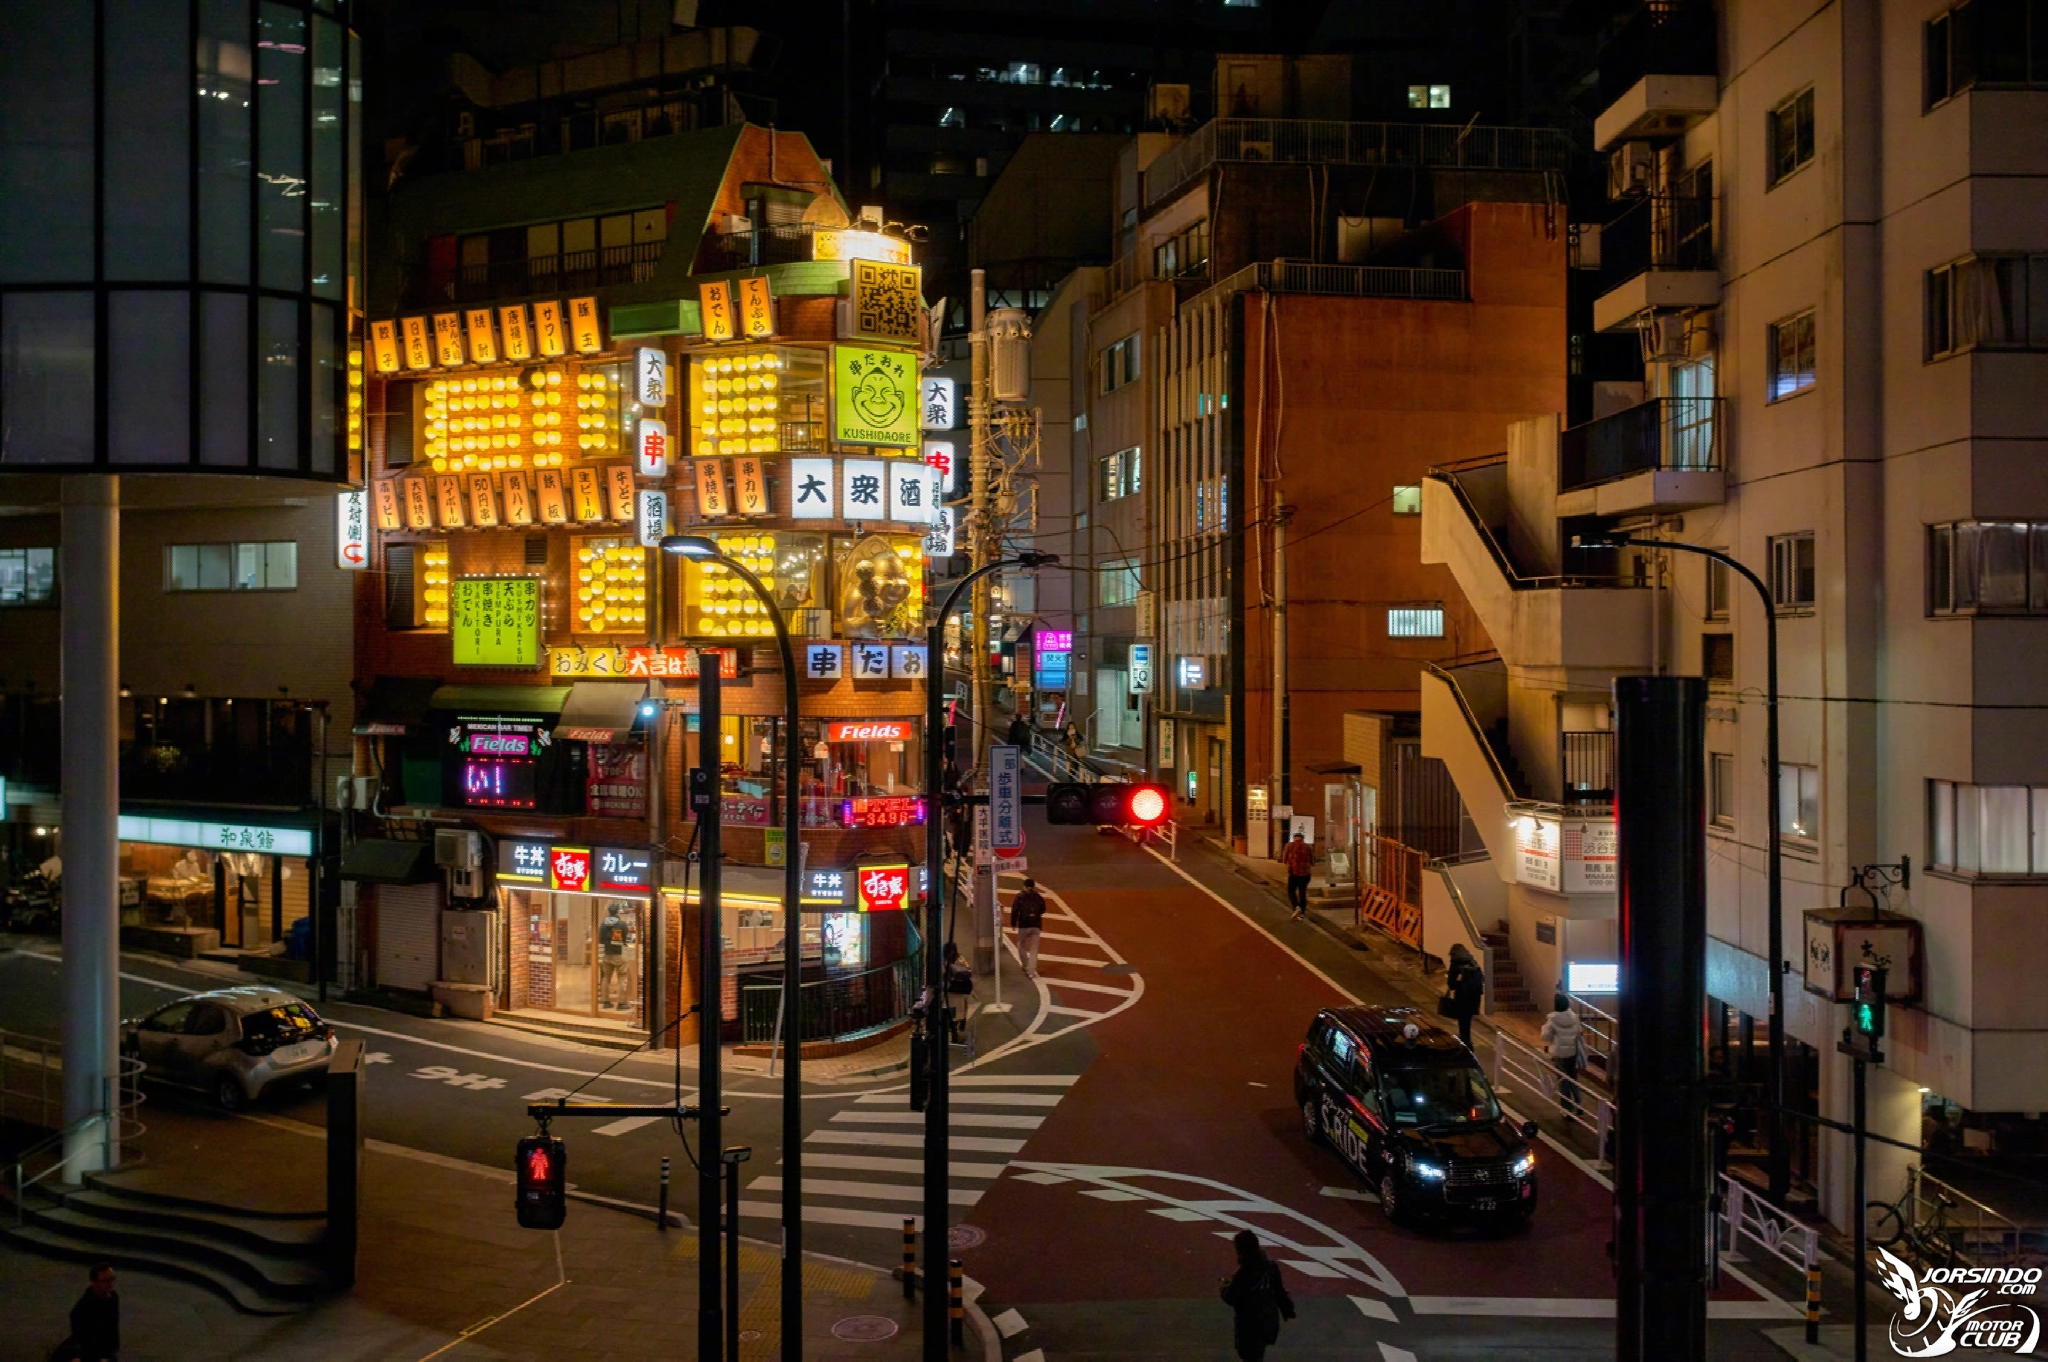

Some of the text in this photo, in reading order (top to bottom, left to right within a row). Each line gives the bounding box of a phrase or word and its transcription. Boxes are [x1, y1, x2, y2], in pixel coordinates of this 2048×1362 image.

[543, 306, 556, 351] サワー
[577, 302, 593, 348] 豚玉
[709, 286, 725, 335] おでん
[748, 279, 765, 333] てんぷら
[378, 325, 393, 368] 餃子
[410, 320, 425, 365] 日本酒
[474, 313, 489, 358] 焼酎
[508, 309, 523, 355] 唐揚げ
[646, 354, 663, 401] 大衆
[927, 382, 948, 425] 大衆
[644, 430, 665, 466] 串
[843, 427, 912, 443] KUSHIDAORE
[380, 481, 394, 526] ホッピー
[412, 480, 425, 526] 大阪焼き
[443, 478, 459, 524] ハイボール
[474, 478, 490, 522] 50円串
[509, 475, 524, 520] 角ハイ
[543, 473, 560, 518] 鉄板
[578, 471, 595, 519] 生ビール
[703, 462, 720, 511] 串焼き
[741, 460, 759, 510] 串カツ
[646, 495, 663, 542] 酒場
[462, 583, 473, 628] おでん
[503, 582, 515, 628] 天ぷら
[524, 582, 536, 628] 串カツ
[555, 650, 735, 675] おみくじ 大吉は無!!
[473, 736, 526, 751] Fields
[569, 729, 611, 740] Fields
[839, 724, 901, 739] Fields
[1004, 753, 1016, 770] 一部
[869, 798, 917, 813] TEL
[997, 771, 1013, 844] 歩車分離式
[514, 845, 546, 867] 牛丼
[602, 852, 648, 873] カレー
[812, 872, 843, 889] 牛丼
